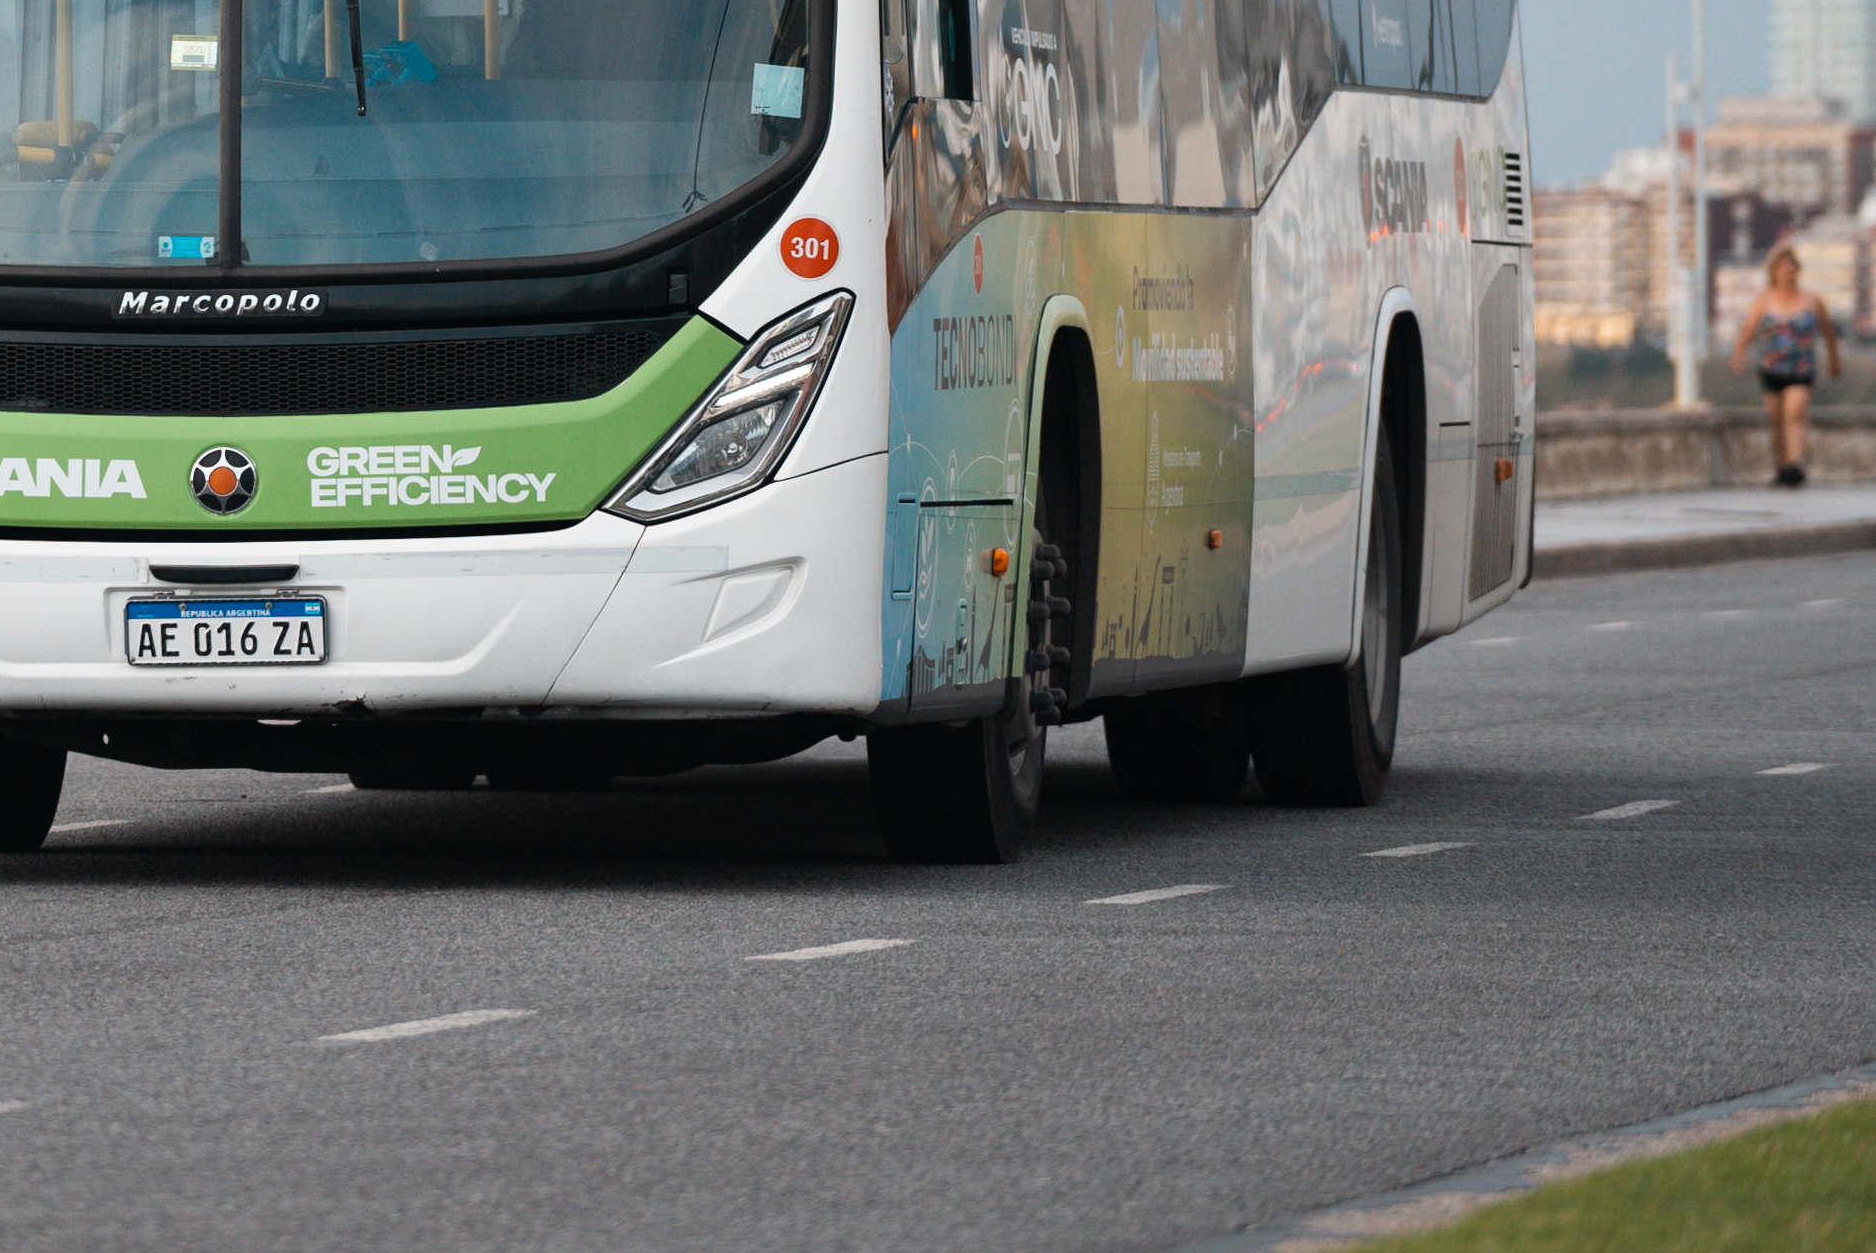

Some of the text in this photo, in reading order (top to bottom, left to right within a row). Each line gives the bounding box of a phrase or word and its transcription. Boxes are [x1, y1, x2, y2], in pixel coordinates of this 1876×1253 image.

[1013, 57, 1062, 155] GNC
[1374, 157, 1429, 235] SCANIA
[790, 236, 830, 261] 301
[119, 289, 321, 316] Marcopolo
[933, 313, 1017, 391] TECNOBONDI
[307, 444, 452, 477] GREEN
[311, 473, 557, 507] EFFICIENCY
[138, 621, 315, 658] AE 016 ZA
